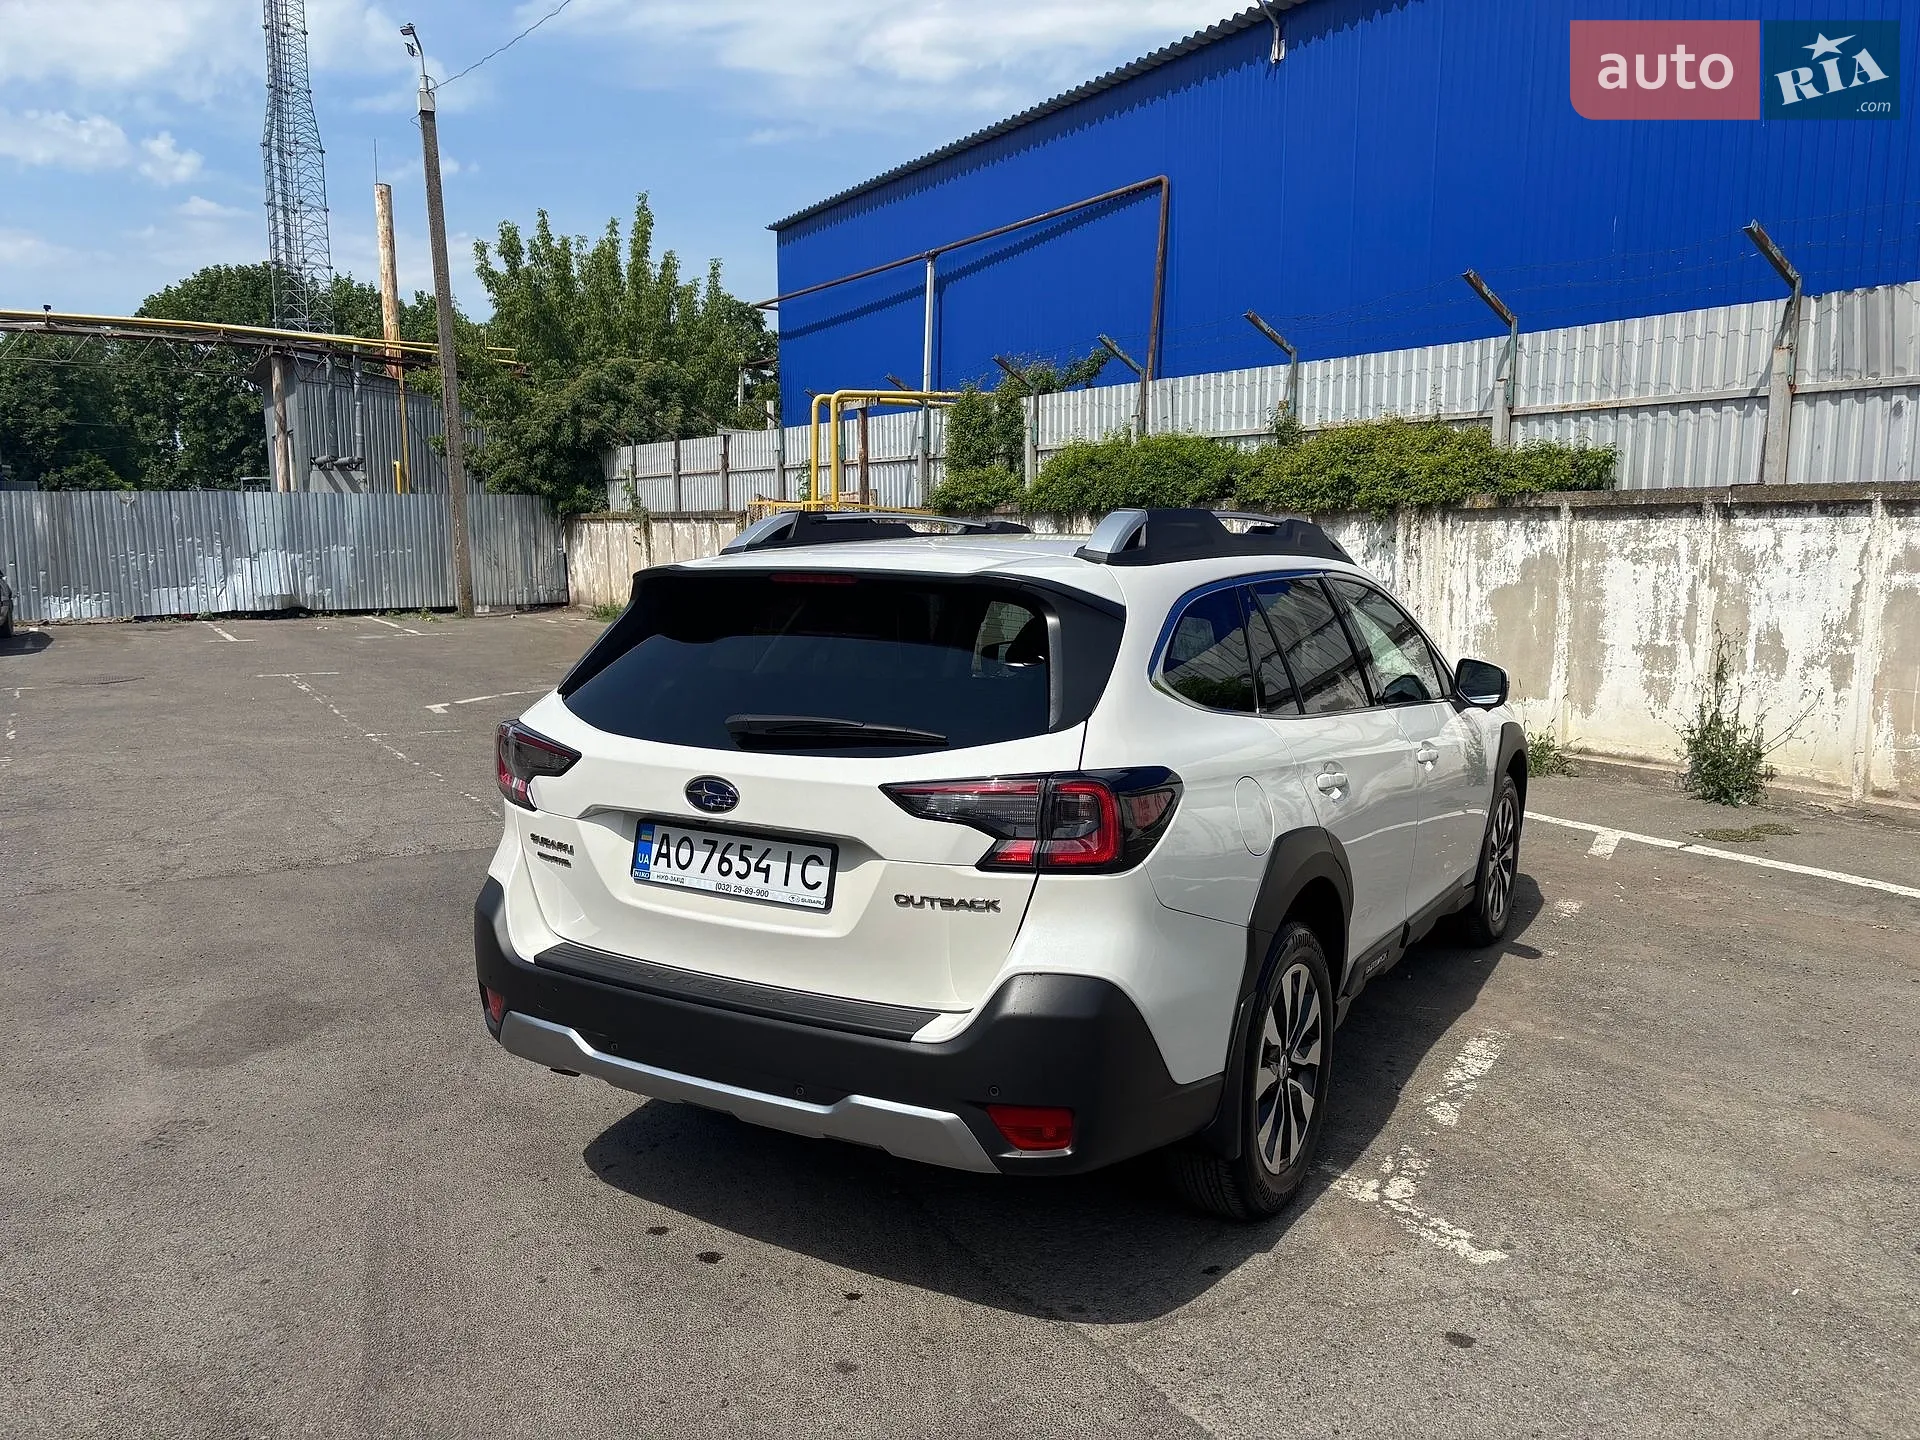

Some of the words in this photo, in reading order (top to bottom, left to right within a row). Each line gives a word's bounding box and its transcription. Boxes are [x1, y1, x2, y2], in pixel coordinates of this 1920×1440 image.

[638, 852, 649, 865] UA
[653, 833, 694, 870] AO
[700, 838, 772, 884] 7654
[783, 850, 824, 891] IC
[715, 882, 732, 893] (032)
[894, 894, 1001, 914] OUTBACK
